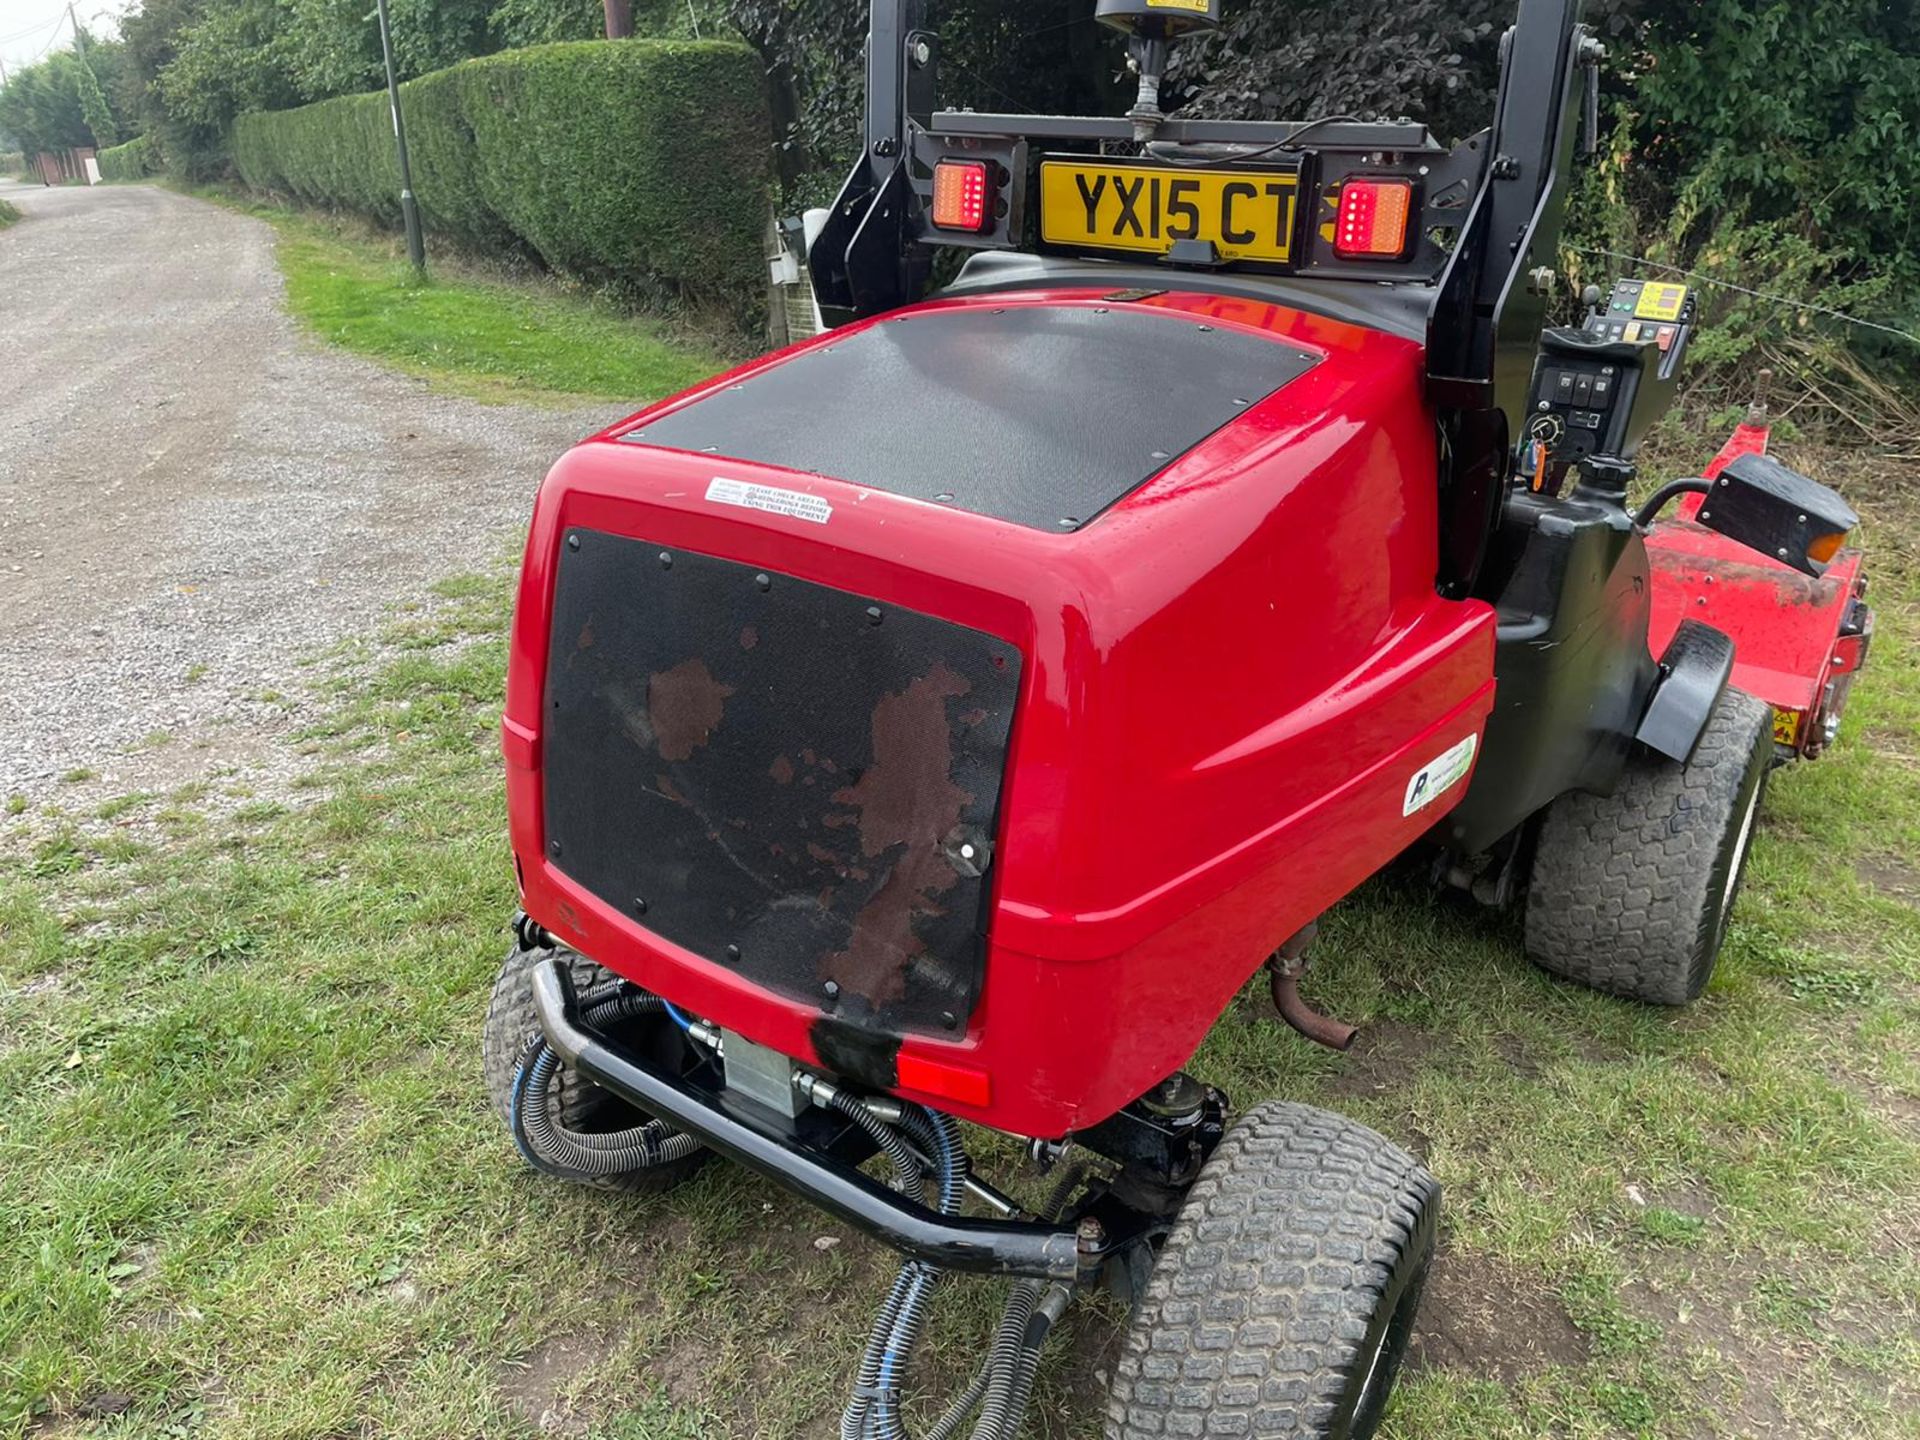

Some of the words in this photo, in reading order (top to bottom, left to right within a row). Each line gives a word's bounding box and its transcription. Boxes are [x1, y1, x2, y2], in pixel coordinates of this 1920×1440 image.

[1075, 173, 1200, 241] YX15
[743, 499, 764, 508] USING
[766, 503, 782, 511] THIS
[783, 507, 826, 521] EQUIPMENT
